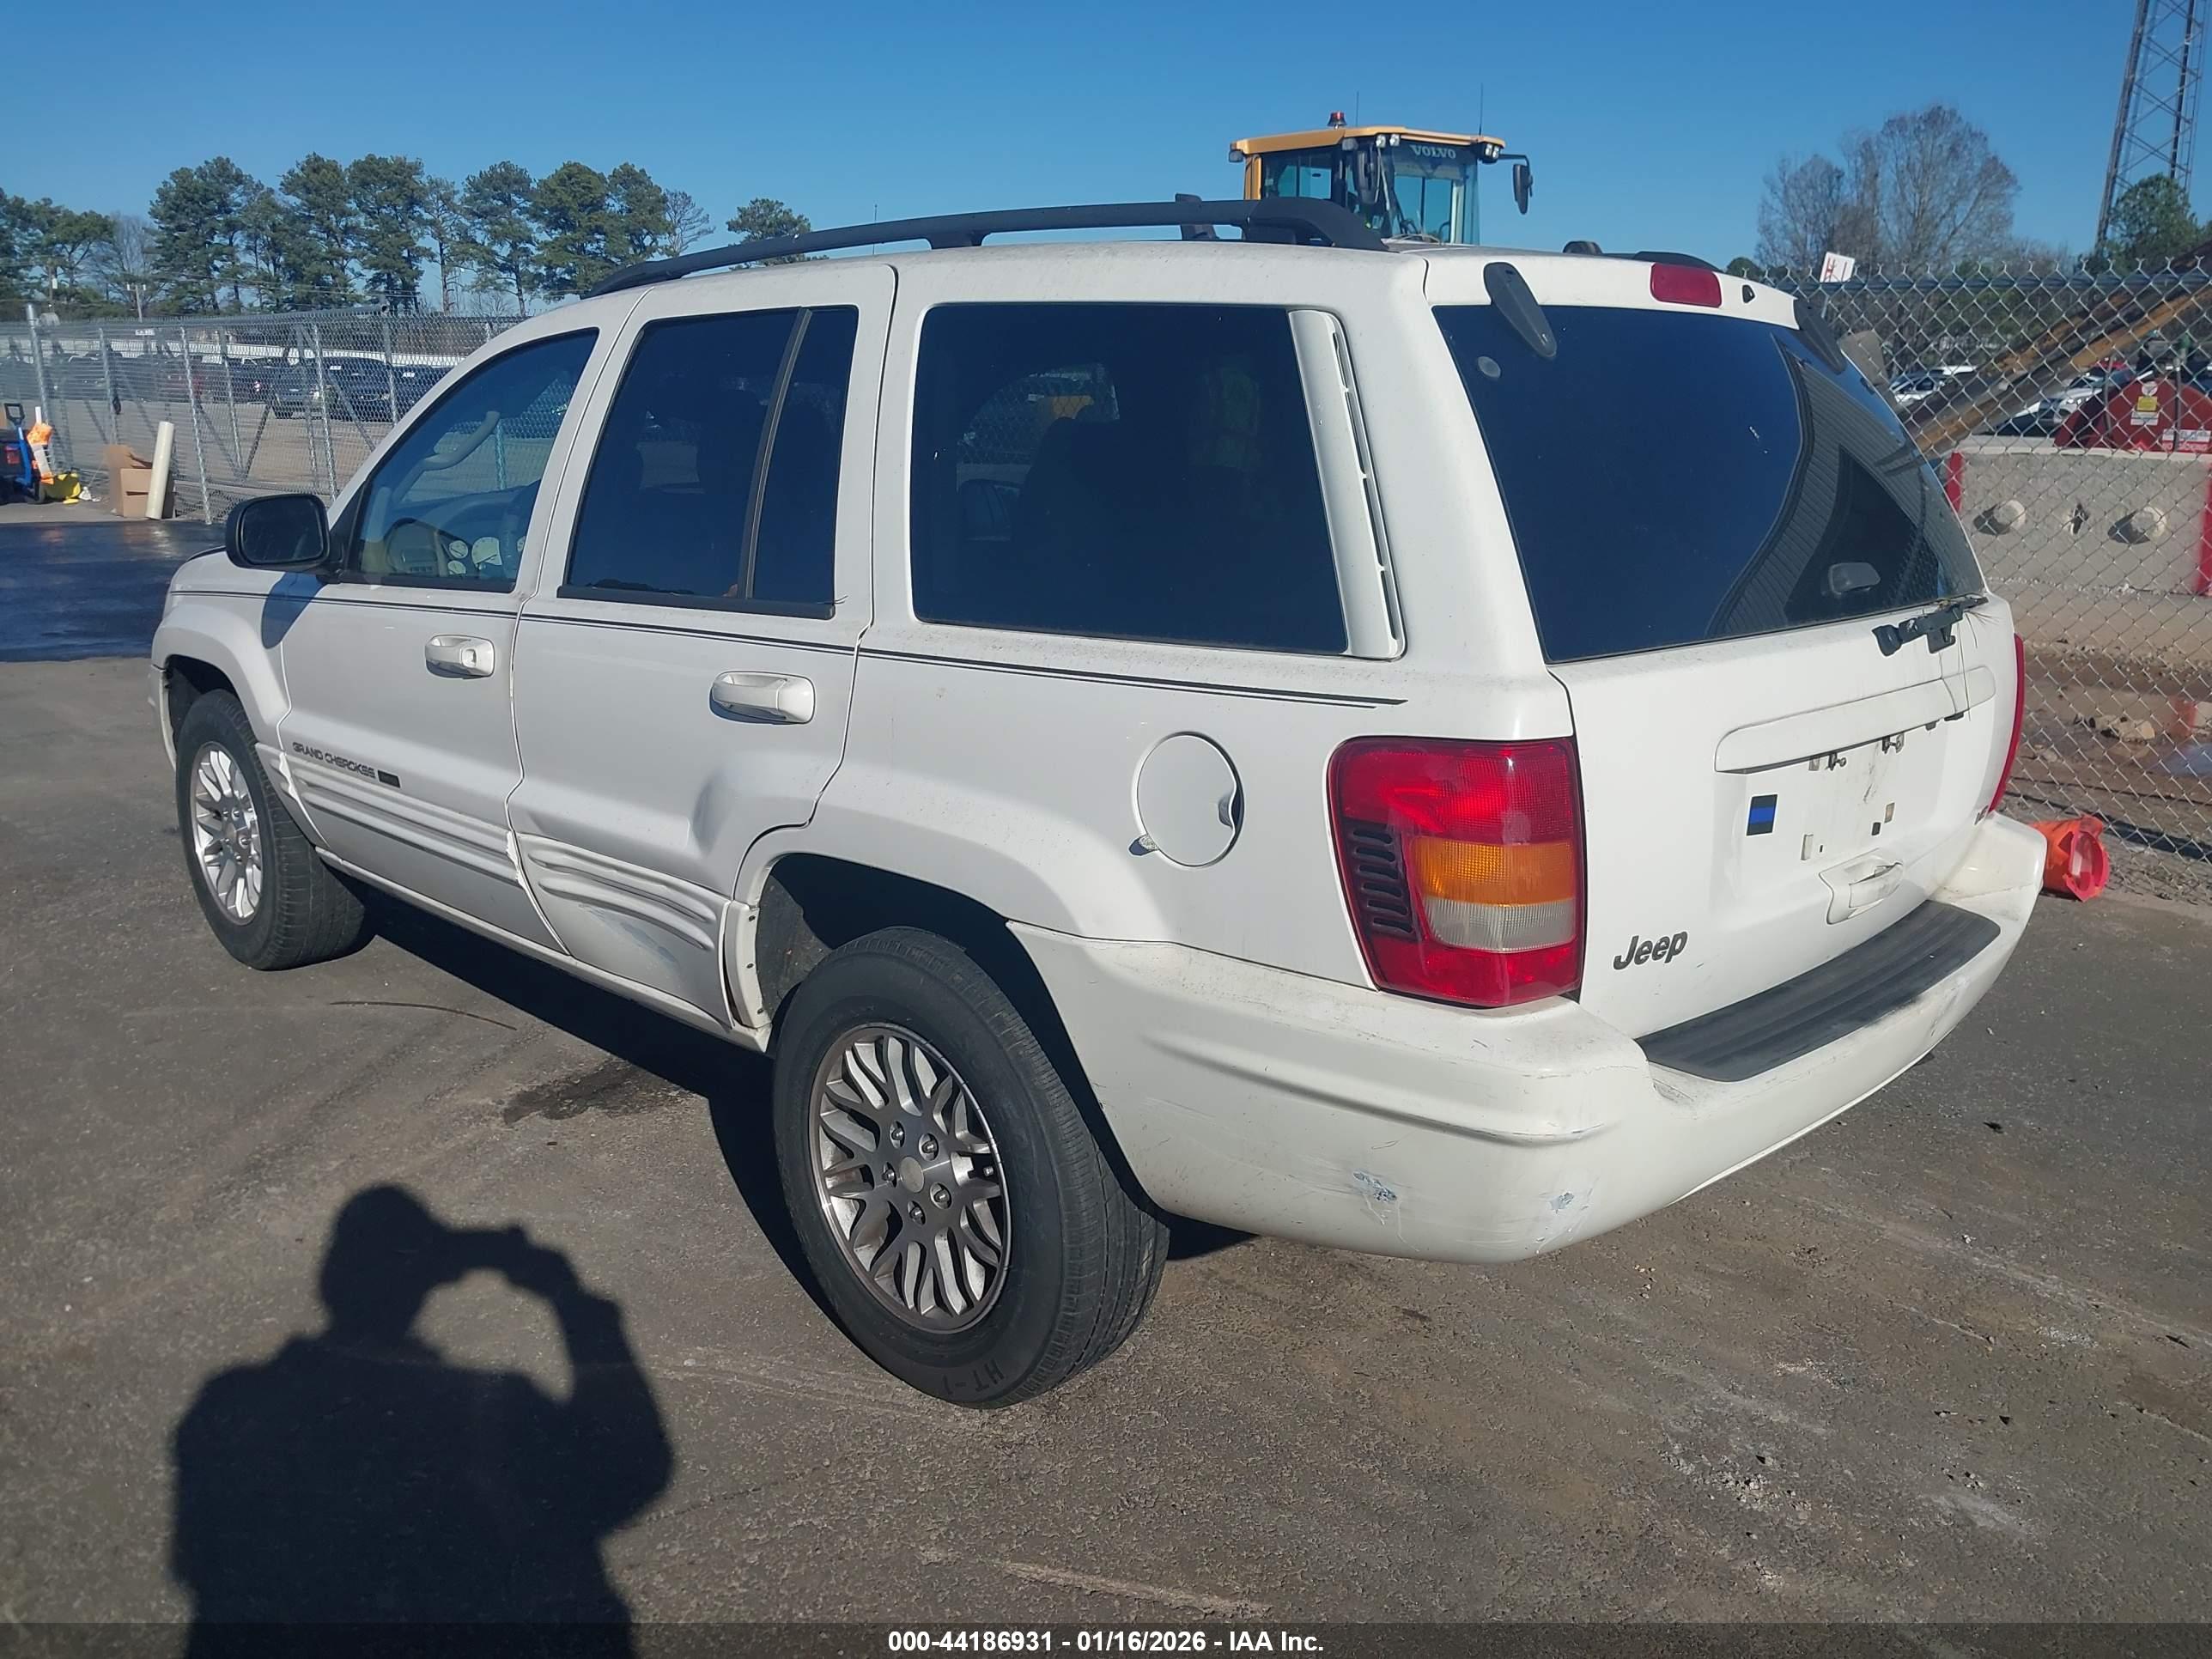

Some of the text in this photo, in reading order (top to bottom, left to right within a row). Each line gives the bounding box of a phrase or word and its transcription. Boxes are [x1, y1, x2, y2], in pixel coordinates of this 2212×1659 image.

[1409, 144, 1456, 159] VOLVO
[292, 741, 324, 761] GRAND
[325, 752, 376, 779] CHEROKEE
[1613, 931, 1688, 970] Jeep
